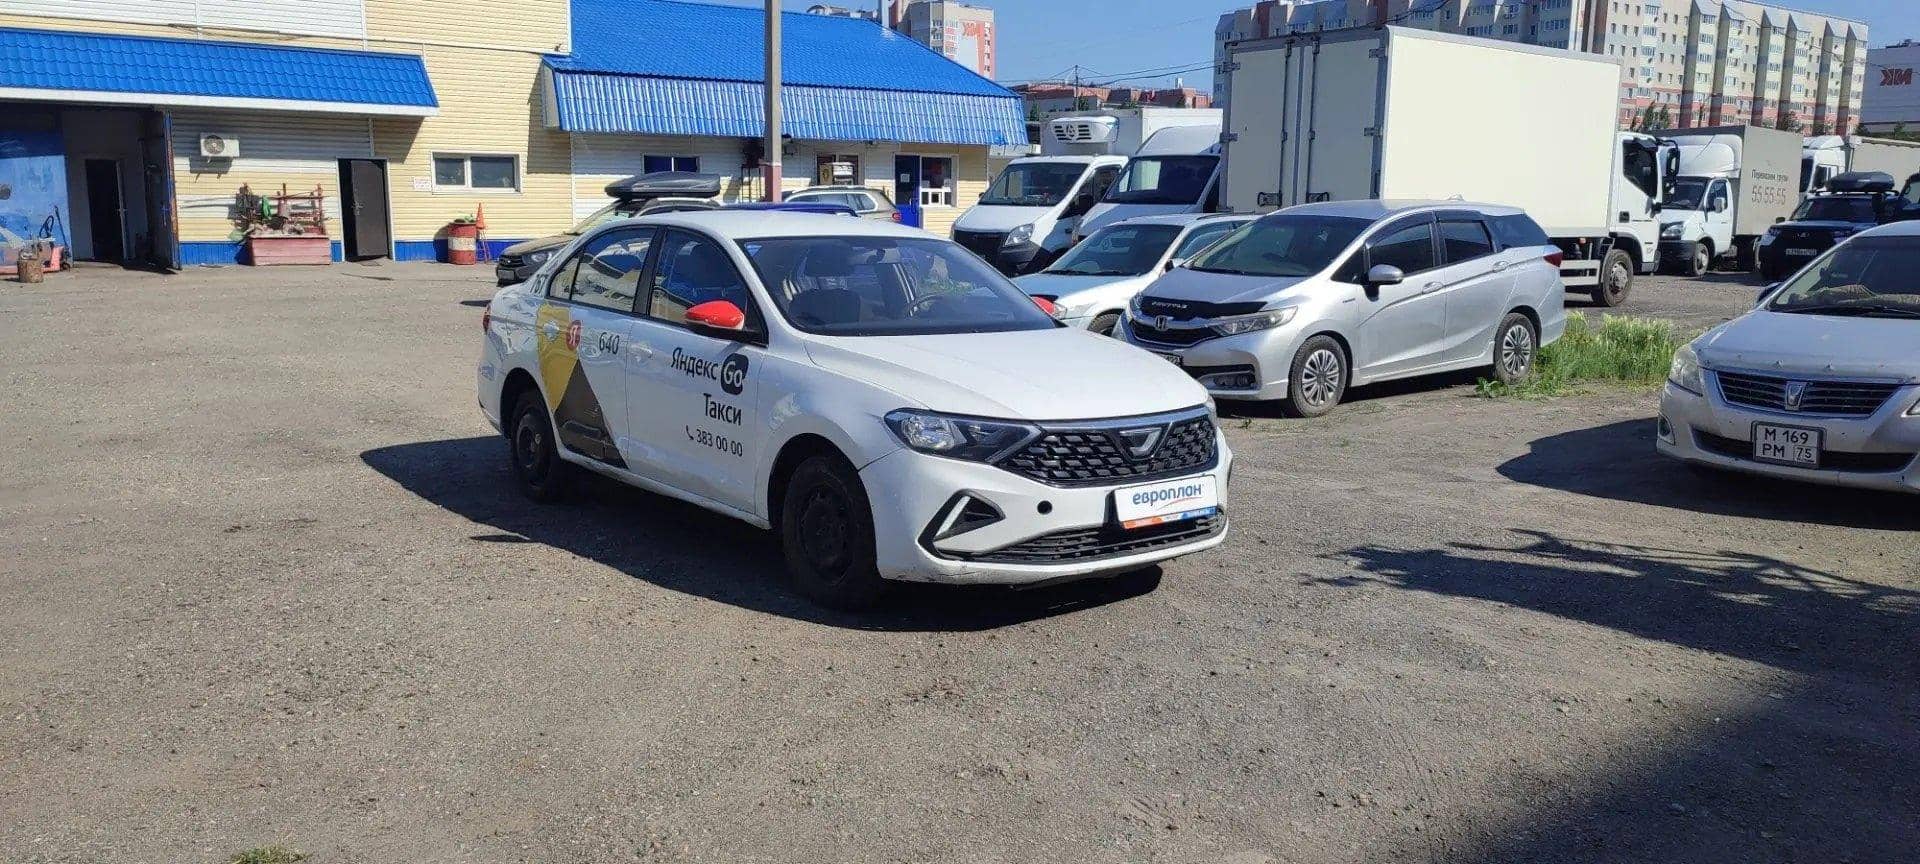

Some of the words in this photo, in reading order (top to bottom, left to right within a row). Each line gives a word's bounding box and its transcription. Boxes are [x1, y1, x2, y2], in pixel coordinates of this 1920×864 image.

[598, 332, 620, 355] 640
[671, 347, 718, 380] Яндекс
[723, 359, 744, 388] Go
[703, 393, 742, 426] Такси
[696, 428, 713, 448] 383
[715, 436, 728, 453] 00
[730, 440, 743, 457] 00
[1764, 427, 1777, 441] М
[1782, 429, 1809, 444] 169
[1762, 443, 1785, 458] РМ
[1796, 446, 1812, 459] 75
[1132, 483, 1202, 507] европлан
